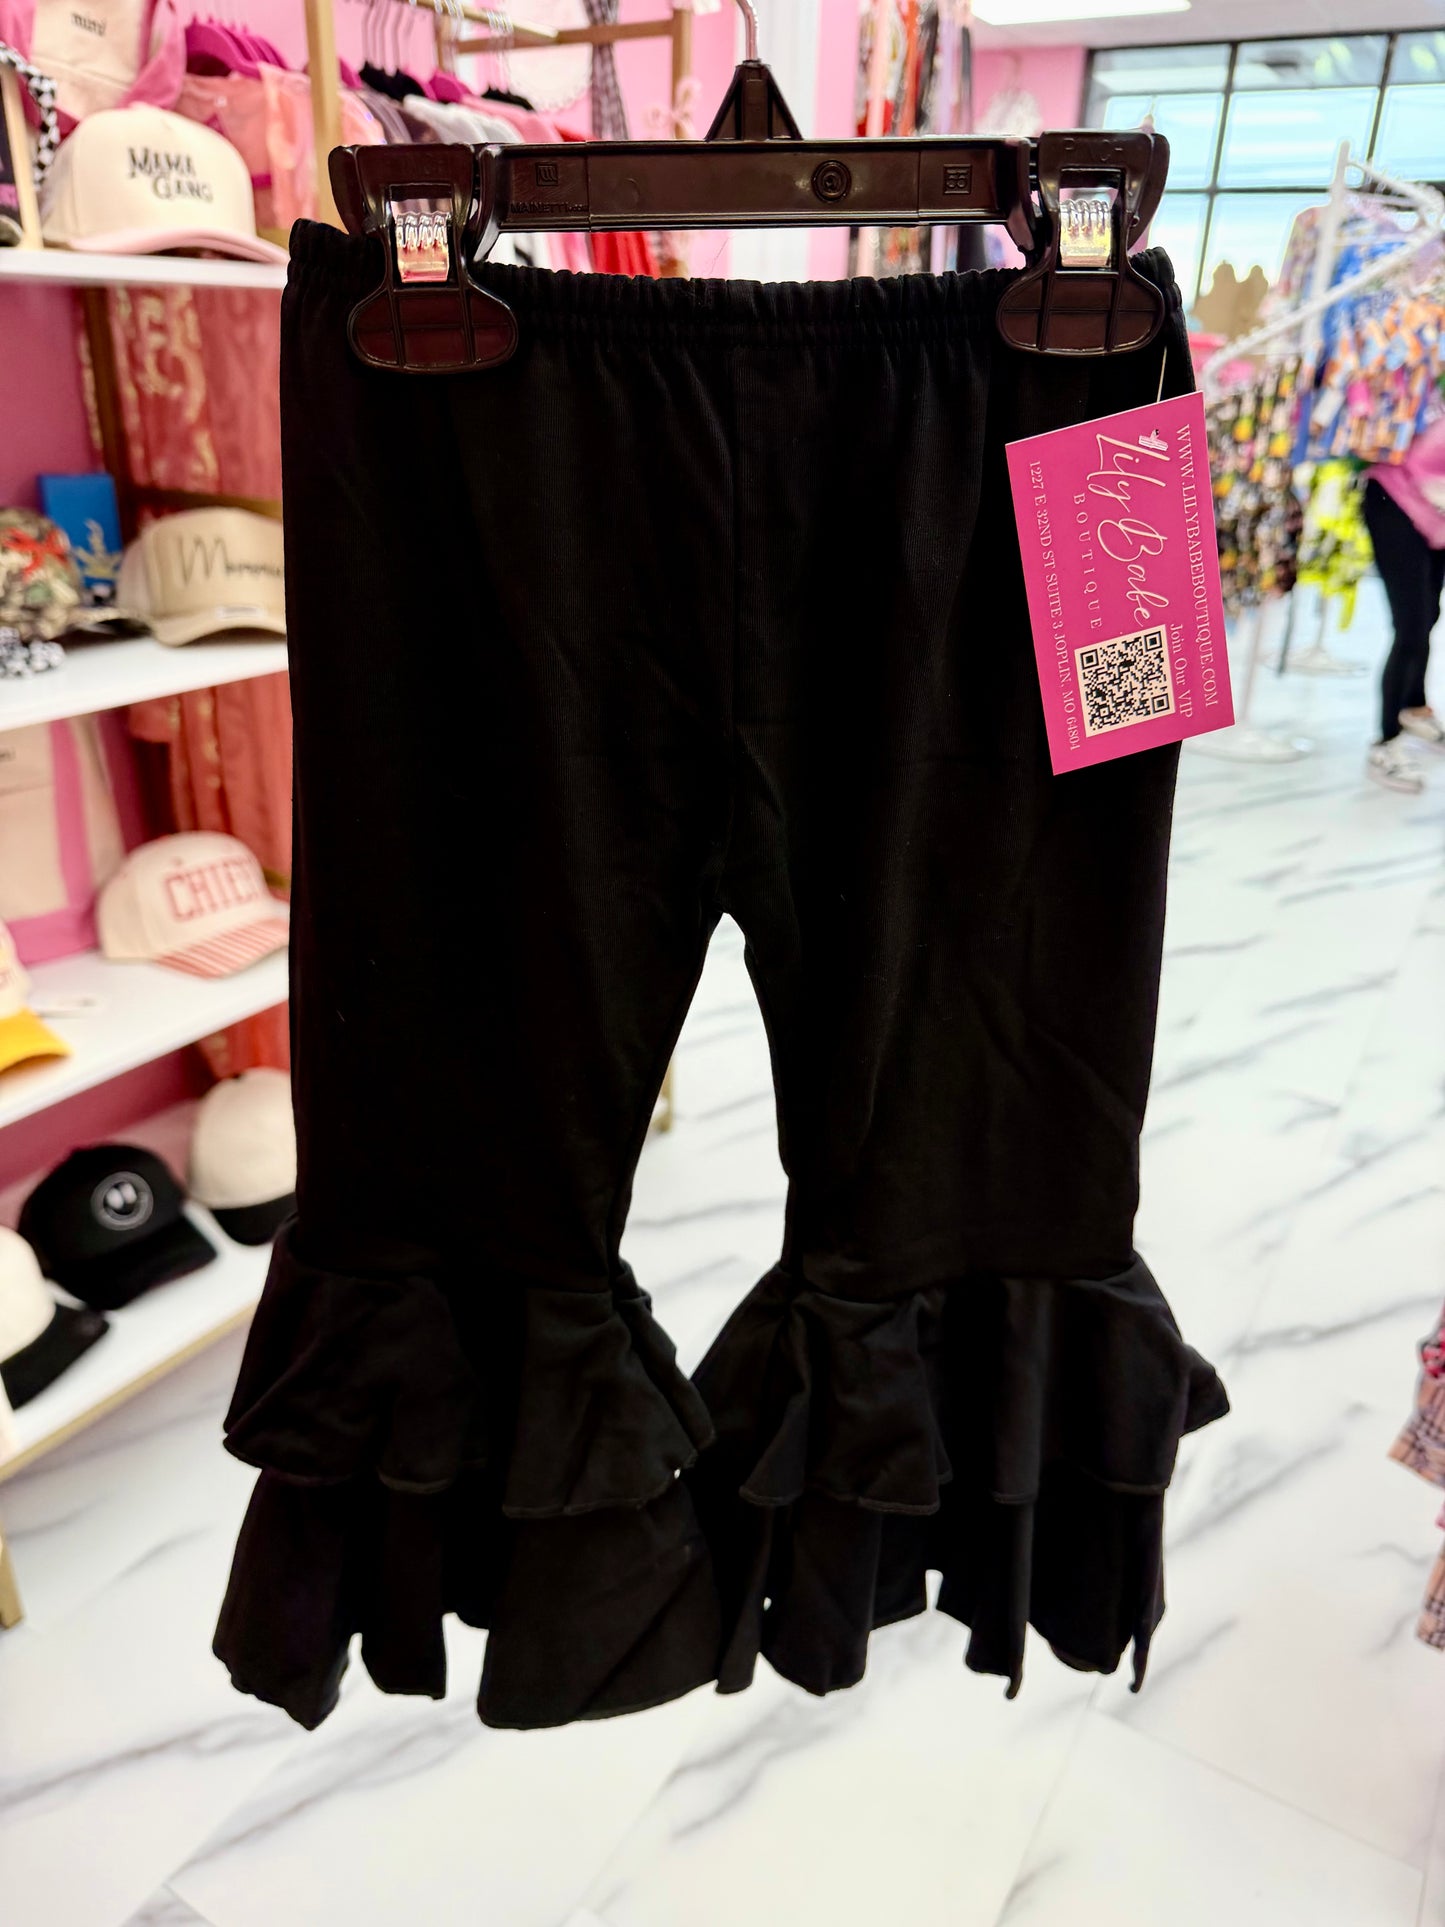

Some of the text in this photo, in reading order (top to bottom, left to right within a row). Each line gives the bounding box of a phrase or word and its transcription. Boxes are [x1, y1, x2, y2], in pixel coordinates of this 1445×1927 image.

[127, 146, 197, 178] MAMA
[152, 174, 214, 203] GANG
[1029, 461, 1044, 490] 1227
[1034, 494, 1047, 506] E
[1037, 509, 1052, 547] 32ND
[1086, 433, 1171, 627] Lily Babe
[1042, 550, 1056, 569] ST
[1073, 492, 1103, 629] BOUTIQUE
[1176, 423, 1218, 707] WWW.LILYBABEBOUTIQUE.COM
[1045, 573, 1063, 618] SUITE
[1052, 620, 1064, 630] 3
[1170, 623, 1193, 718] Join Our VIP
[1062, 690, 1077, 713] MO
[1066, 716, 1081, 751] 64804
